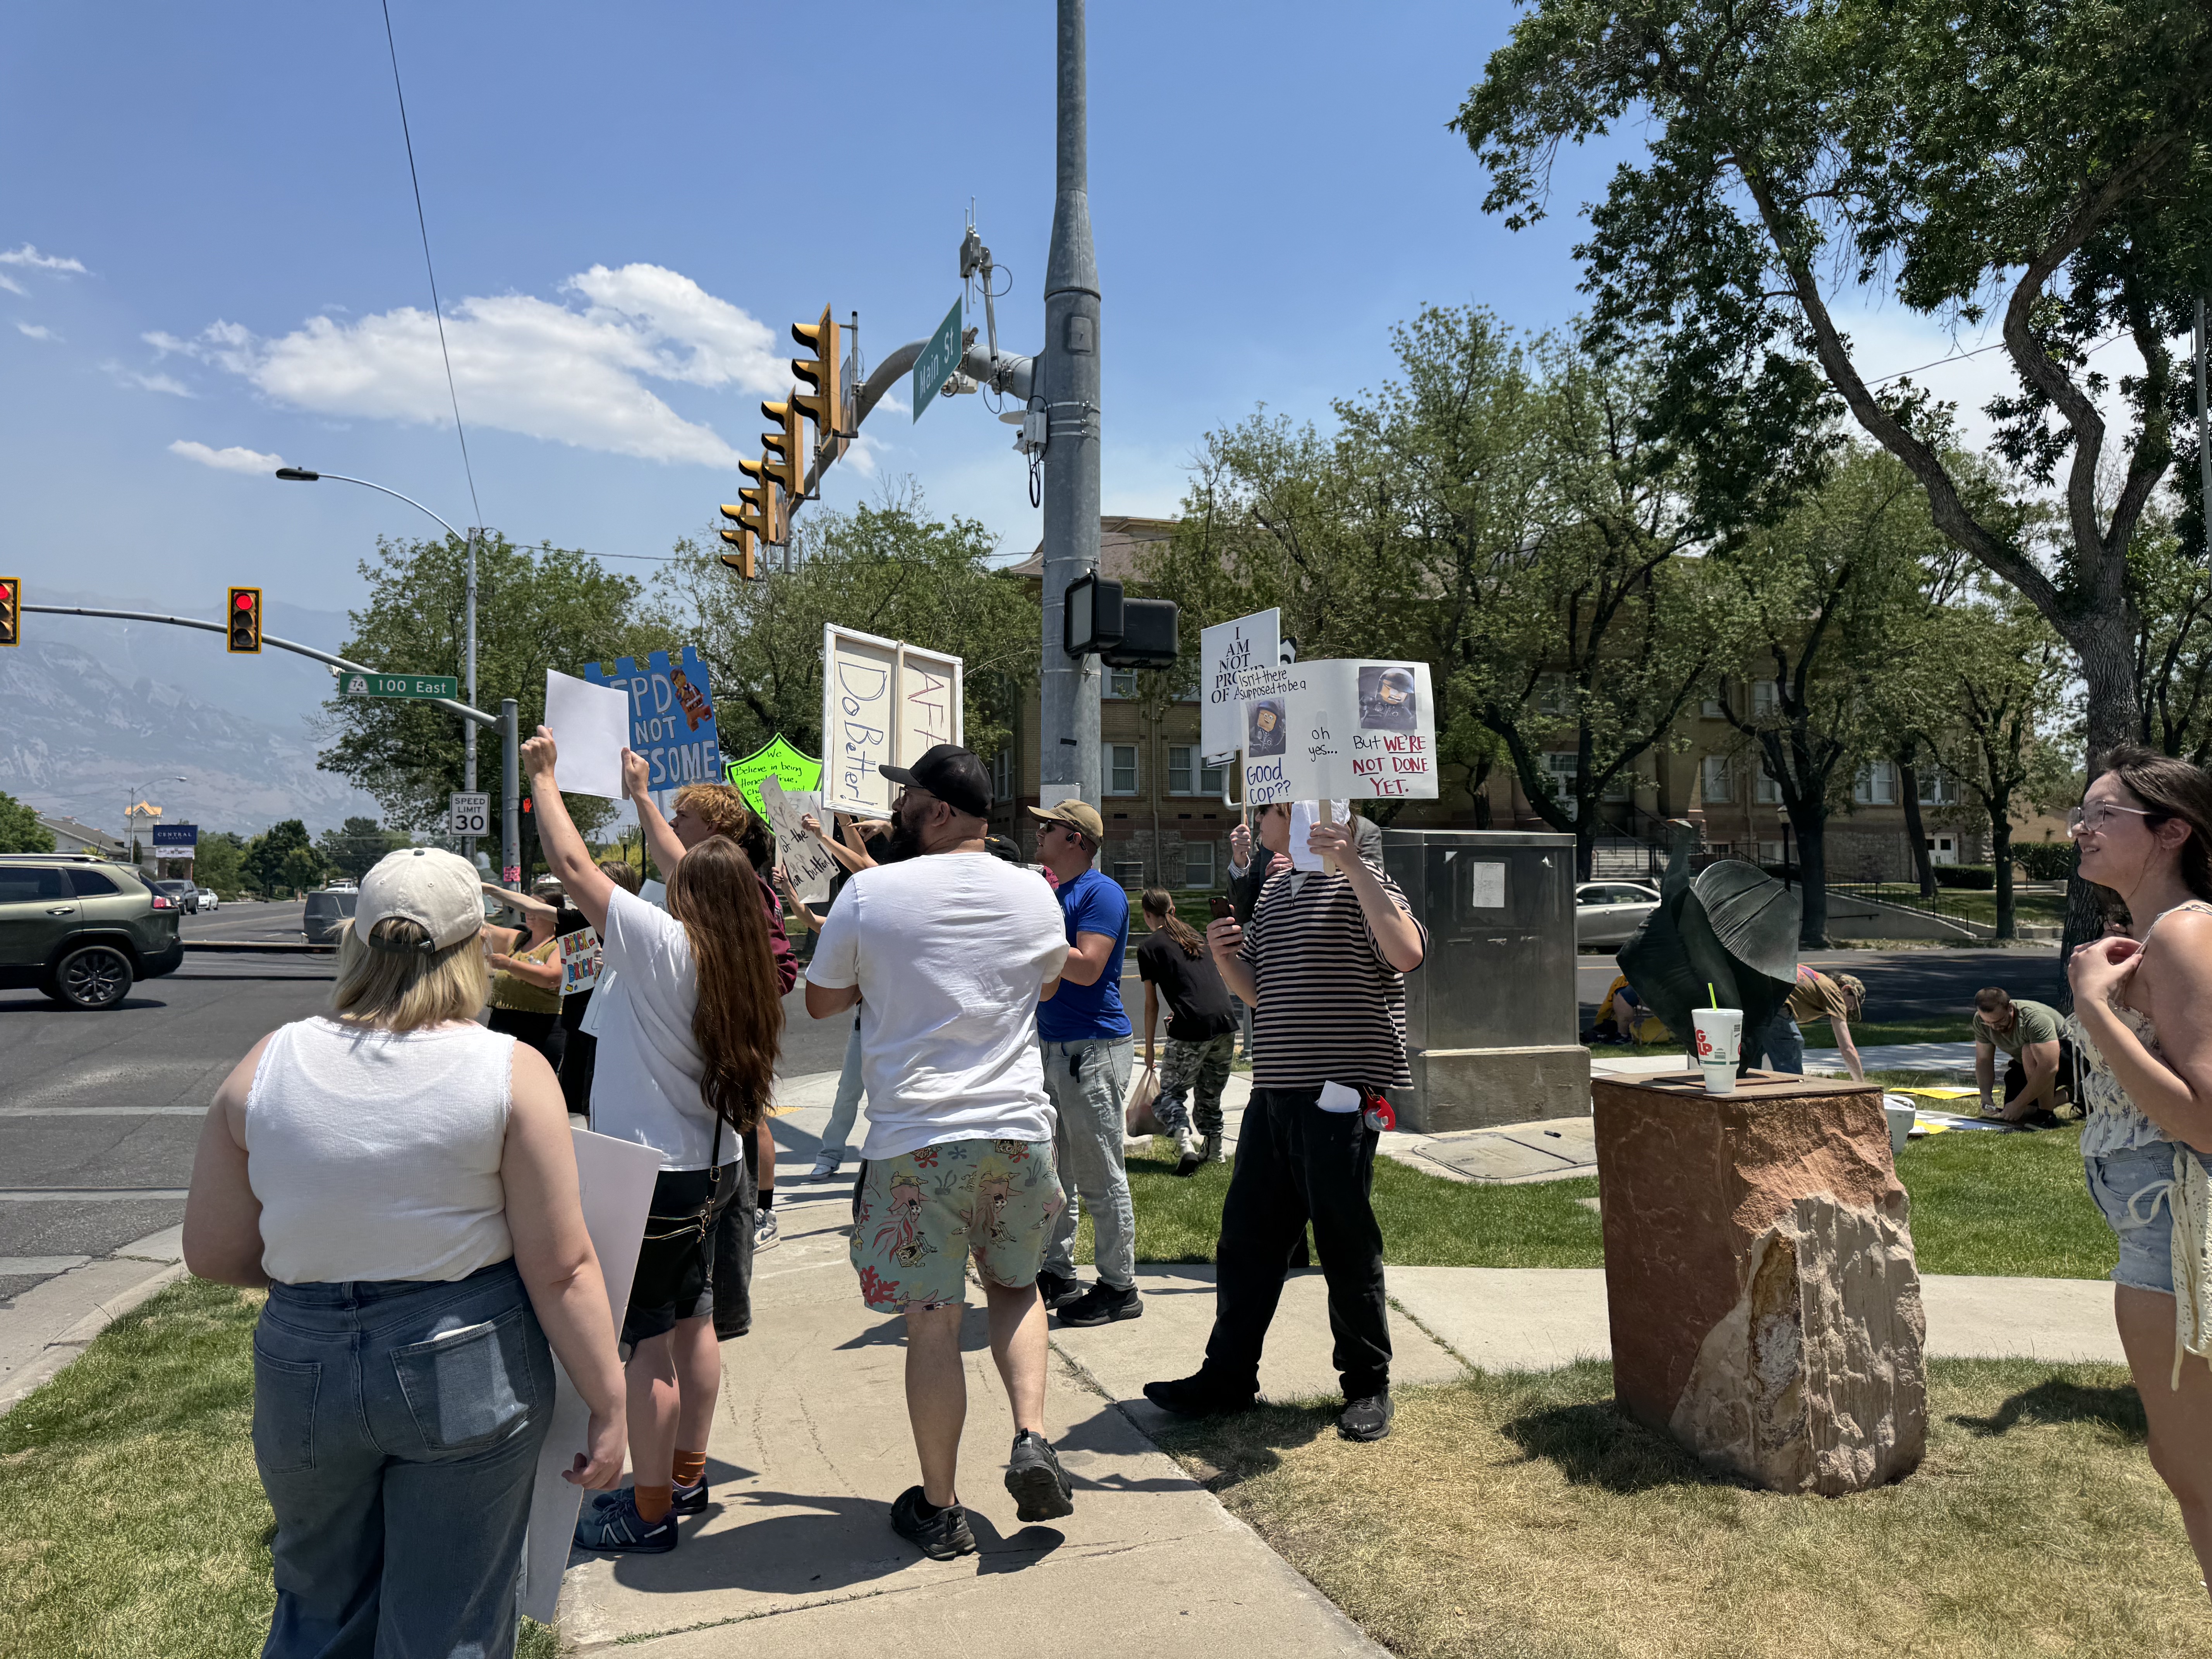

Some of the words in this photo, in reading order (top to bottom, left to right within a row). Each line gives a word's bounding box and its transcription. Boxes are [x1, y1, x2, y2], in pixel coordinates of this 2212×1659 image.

[919, 354, 938, 399] Main
[944, 326, 954, 364] St
[1235, 626, 1240, 640] I
[1225, 639, 1250, 657] AM
[1219, 653, 1250, 673] NOT
[379, 680, 406, 692] 100
[416, 681, 447, 694] East
[1239, 672, 1261, 687] Isn't
[1262, 670, 1287, 684] there
[837, 661, 888, 716] Do
[1211, 687, 1229, 704] OF
[1239, 682, 1275, 700] supposed
[1276, 683, 1286, 694] to
[1288, 679, 1299, 692] be
[1300, 680, 1306, 690] a
[635, 716, 677, 745] NOT
[1383, 734, 1426, 752] WE'RE
[767, 749, 782, 757] We
[736, 766, 767, 776] Believe
[781, 761, 802, 776] being
[1352, 757, 1386, 774] NOT
[1392, 757, 1429, 772] DONE
[1370, 777, 1409, 797] YET.
[455, 815, 484, 830] 30
[780, 835, 791, 853] of
[790, 828, 809, 843] the
